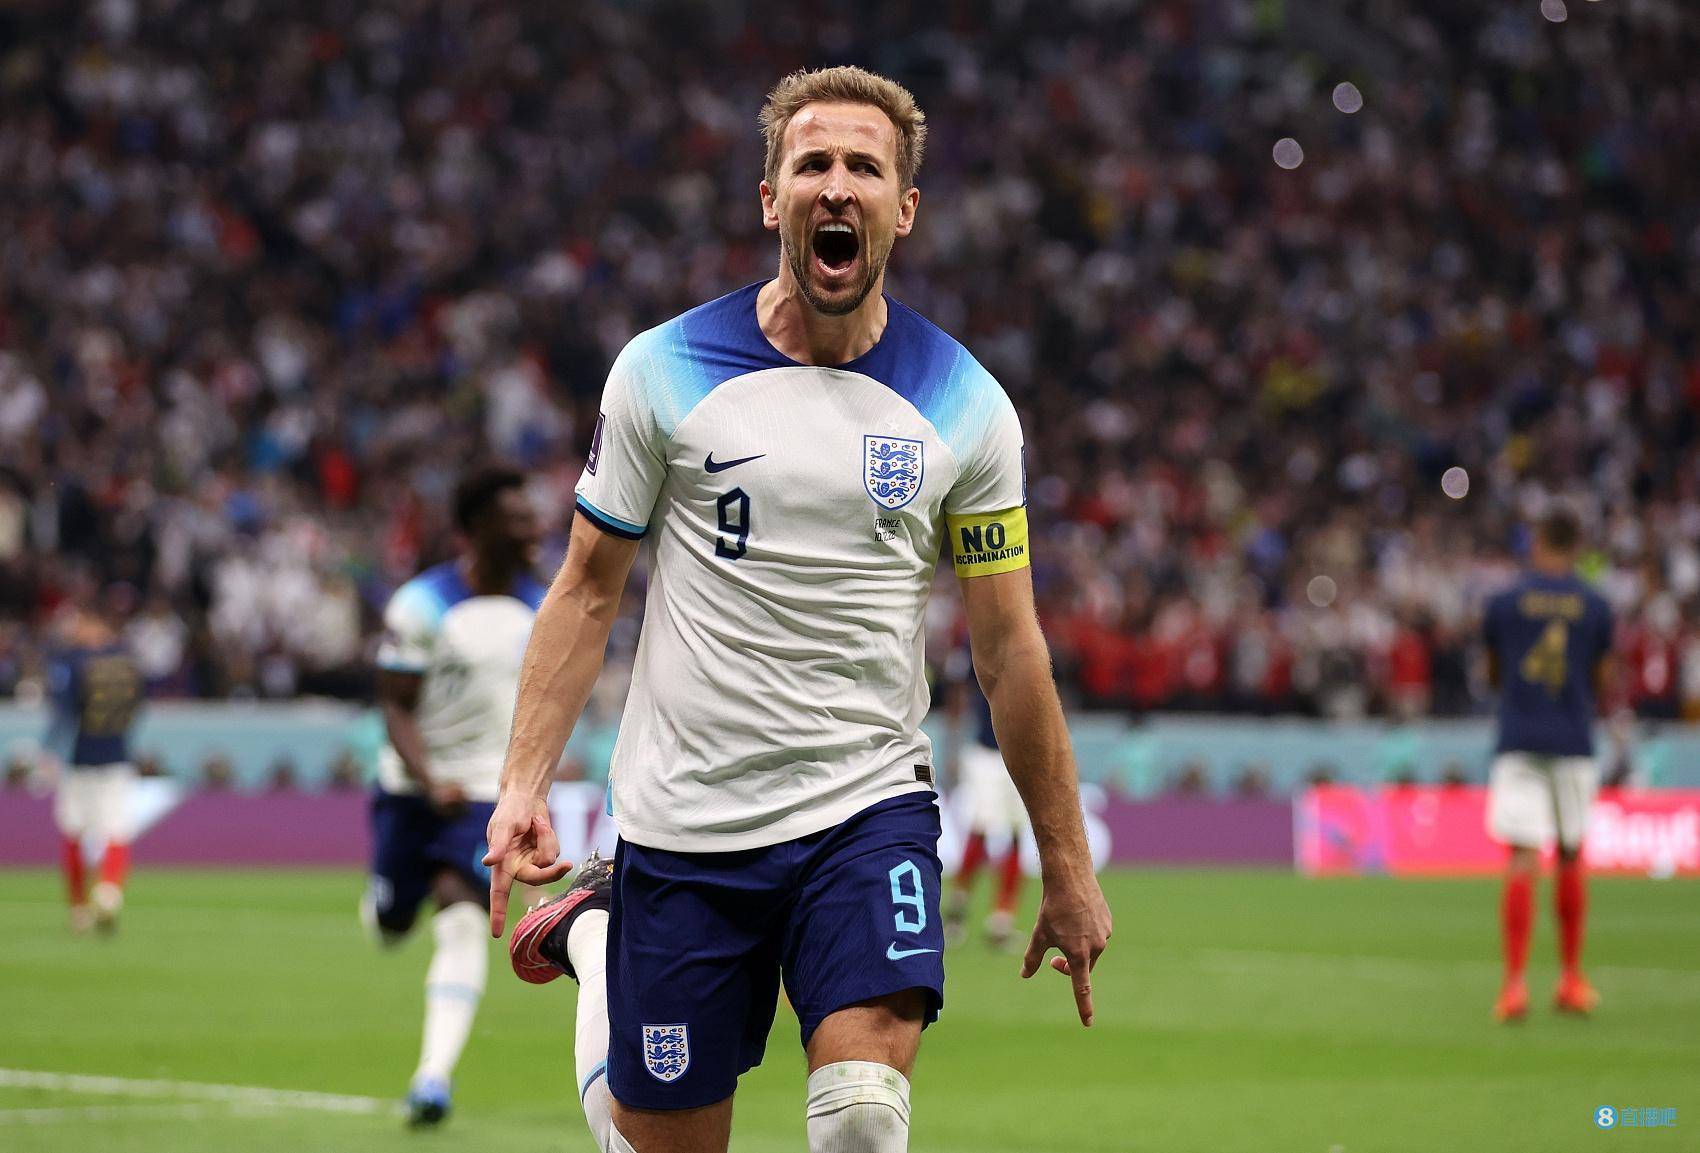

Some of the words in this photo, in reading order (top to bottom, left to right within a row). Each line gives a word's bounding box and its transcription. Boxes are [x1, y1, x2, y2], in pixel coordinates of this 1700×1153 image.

[715, 486, 750, 560] 9
[875, 518, 901, 529] FRANCE
[961, 523, 1005, 553] NO
[956, 545, 1024, 565] ISCRIMINATION
[1519, 618, 1568, 697] 4
[889, 860, 926, 934] 9
